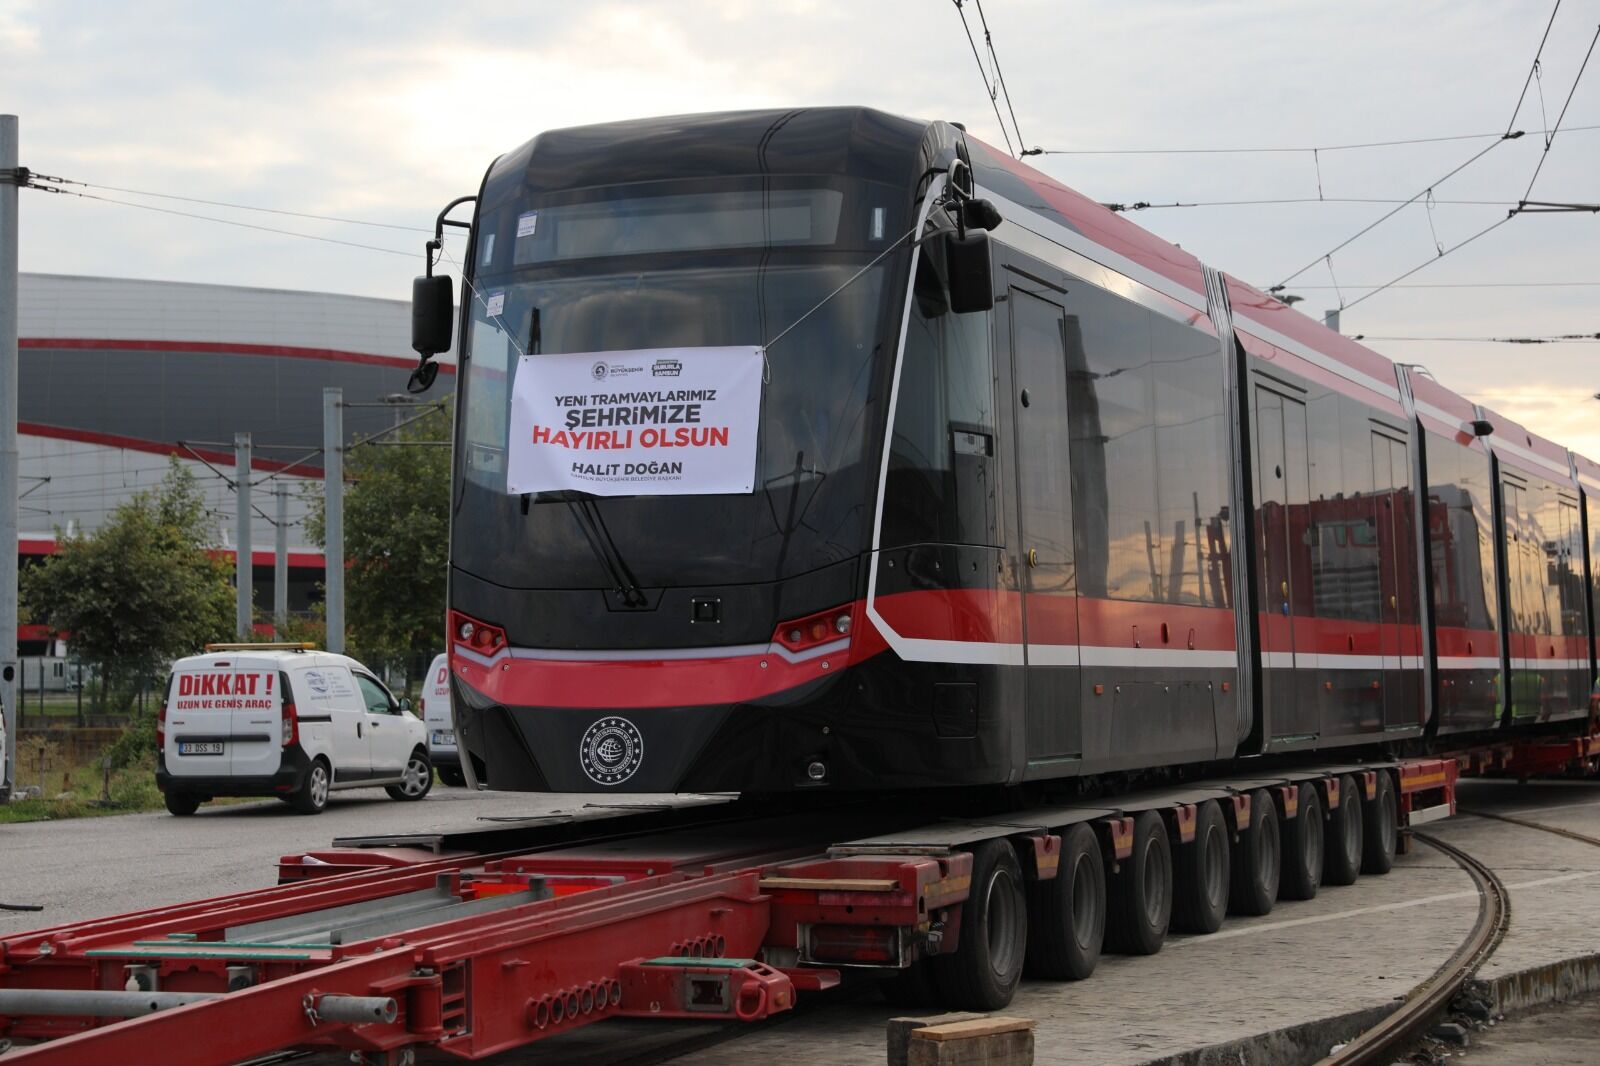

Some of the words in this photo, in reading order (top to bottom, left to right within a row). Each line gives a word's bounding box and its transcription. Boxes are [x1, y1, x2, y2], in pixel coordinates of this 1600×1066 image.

[555, 395, 587, 407] YENİ
[590, 389, 717, 406] TRAMVAYLARIMIZ
[564, 404, 701, 430] ŞEHRİMİZE
[532, 425, 633, 450] HAYIRLI
[639, 427, 729, 449] OLSUN
[572, 462, 620, 475] HALİT
[624, 461, 682, 475] DOĞAN
[179, 674, 260, 696] DİKKAT
[177, 700, 200, 710] UZUN
[201, 700, 213, 709] VE
[214, 699, 243, 710] GENİŞ
[244, 699, 273, 710] ARAÇ
[183, 743, 192, 753] 33
[212, 743, 220, 753] 19
